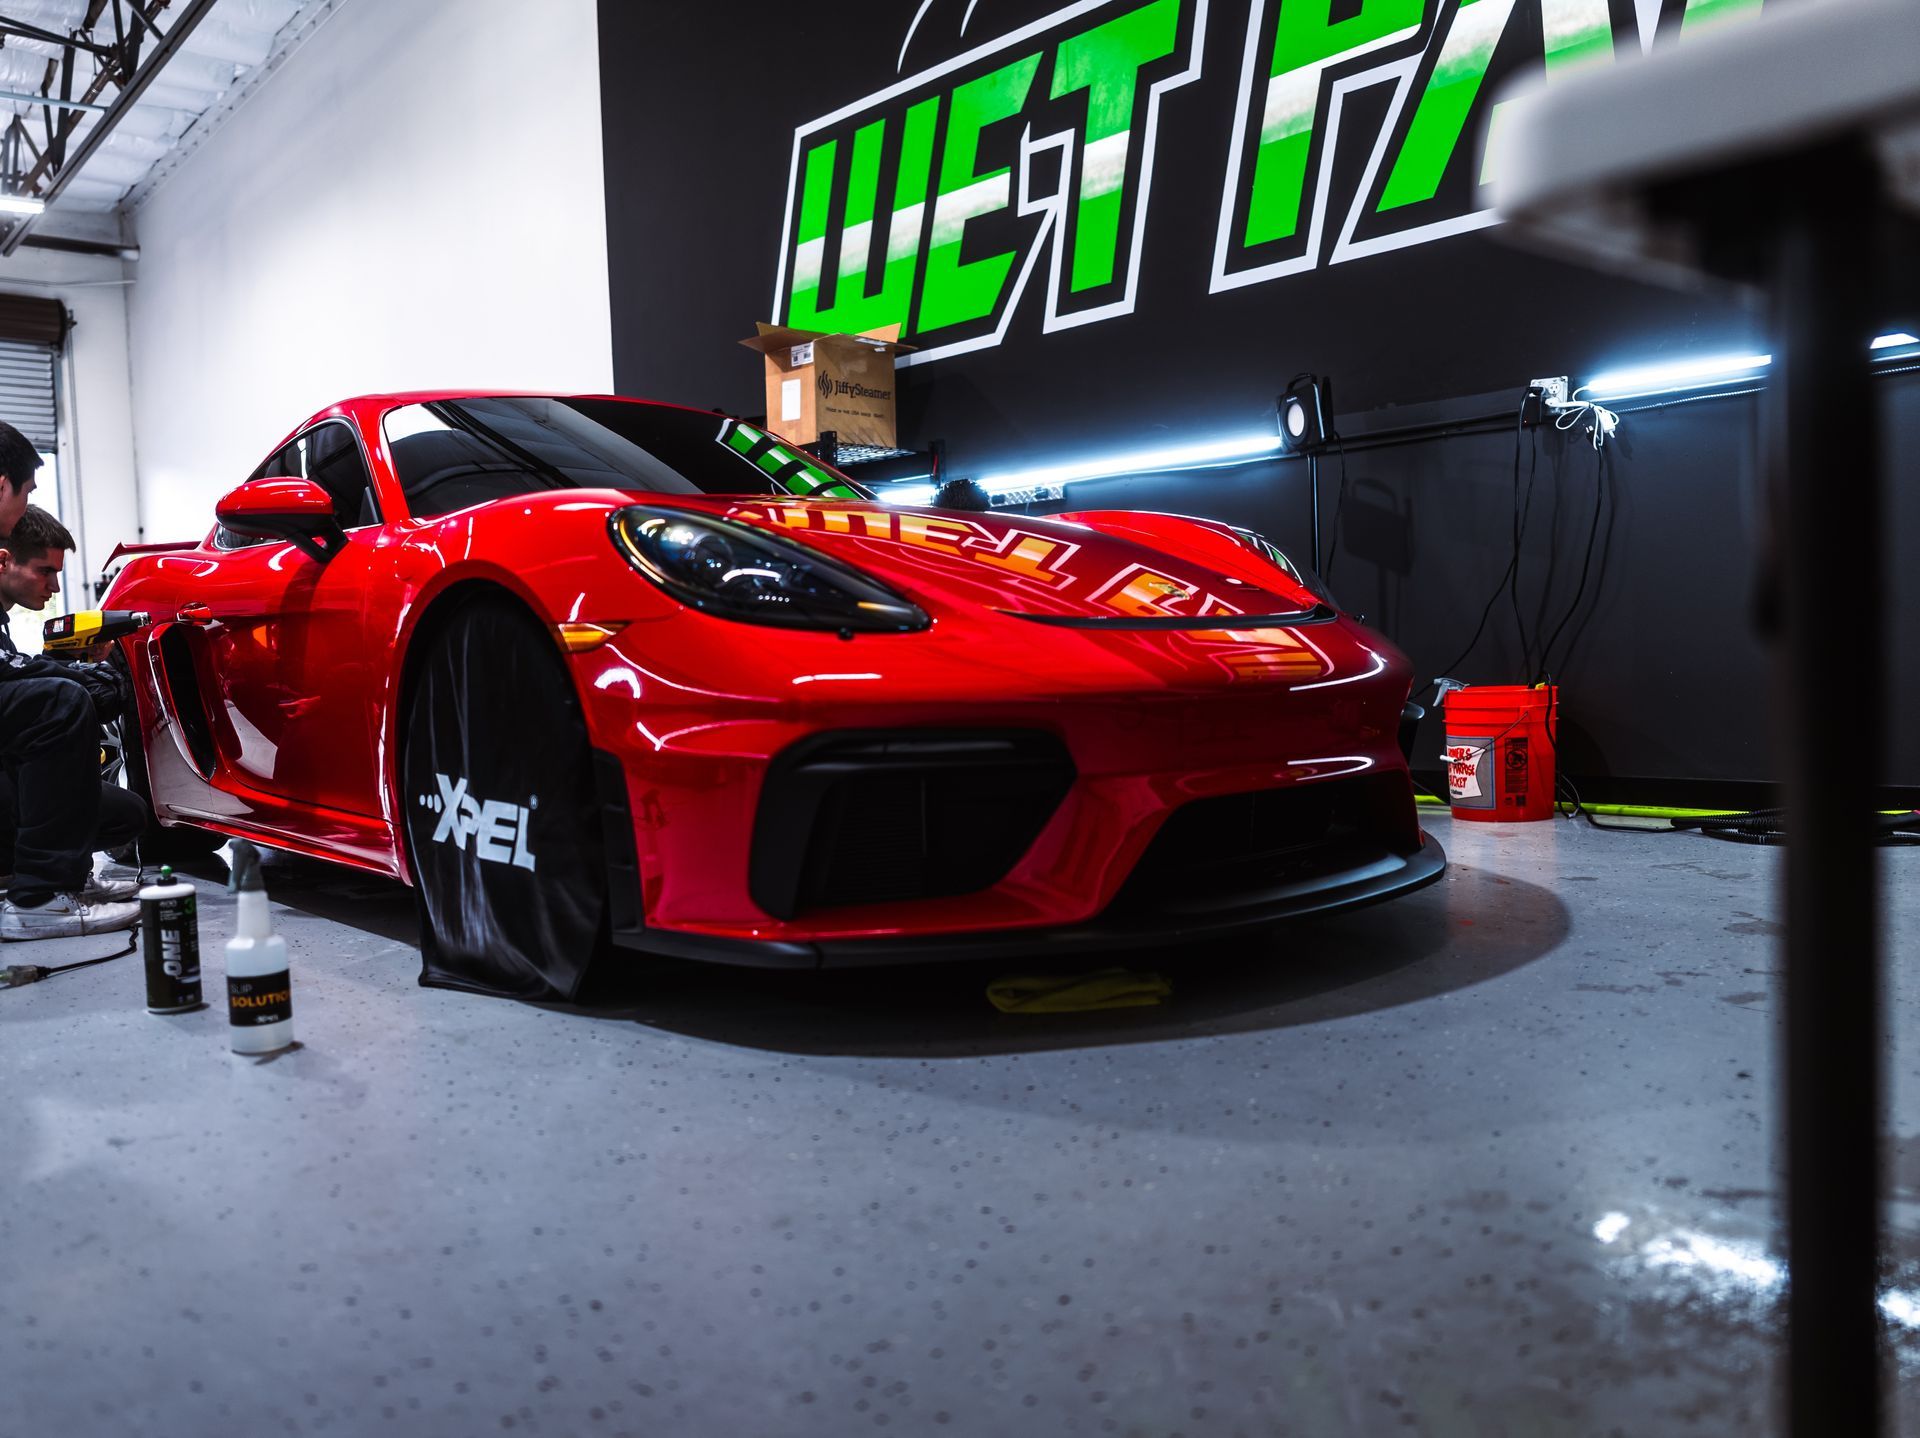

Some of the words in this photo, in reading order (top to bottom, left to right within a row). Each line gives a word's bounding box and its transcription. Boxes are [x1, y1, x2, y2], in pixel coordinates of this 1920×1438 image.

[782, 0, 1186, 339] WET
[431, 772, 537, 873] XPEL
[160, 928, 183, 977] ONE
[231, 989, 289, 1008] SOLUTIO
